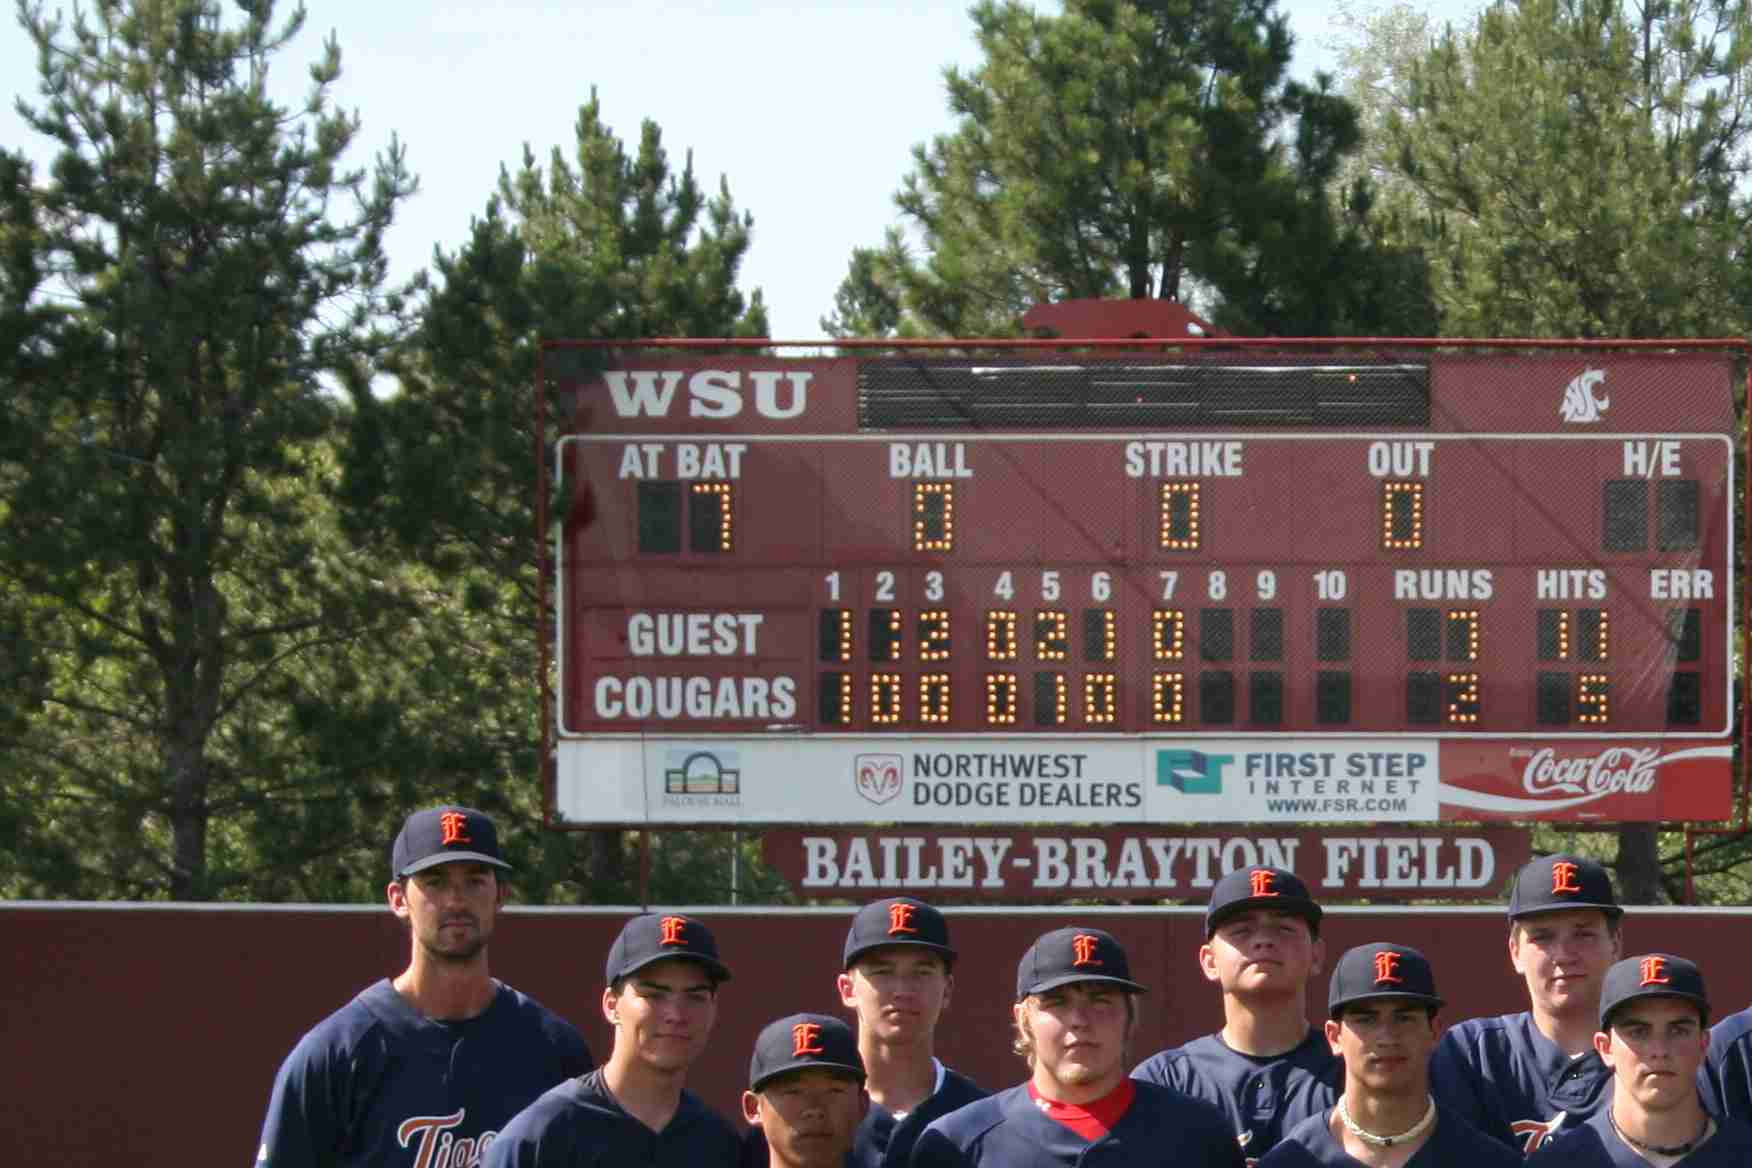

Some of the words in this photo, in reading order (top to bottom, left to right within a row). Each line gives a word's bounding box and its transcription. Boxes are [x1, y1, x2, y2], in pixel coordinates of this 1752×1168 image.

[605, 369, 814, 420] WSU
[618, 442, 665, 479] AT
[676, 442, 748, 479] BAT
[888, 440, 974, 479] BALL
[1124, 439, 1243, 479] STRIKE
[1367, 440, 1435, 478] OUT
[1622, 440, 1682, 479] H/E
[693, 483, 732, 550] 7
[915, 482, 954, 551] 0
[1160, 482, 1201, 550] 0
[1383, 481, 1423, 549] 0
[825, 570, 840, 602] 1
[875, 570, 896, 602] 2
[925, 570, 945, 602] 3
[993, 570, 1015, 602] 4
[1040, 570, 1061, 602] 5
[1091, 570, 1112, 602] 6
[1159, 570, 1179, 601] 7
[1207, 570, 1227, 602] 8
[1256, 569, 1277, 601] 9
[1313, 569, 1347, 601] 10
[1394, 568, 1493, 601] RUNS
[1536, 568, 1607, 601] HITS
[1650, 568, 1714, 600] ERR
[628, 613, 764, 656] GUEST
[920, 610, 949, 660] 2
[986, 610, 1017, 660] 0
[1037, 610, 1066, 660] 2
[1153, 610, 1184, 659] 0
[1449, 610, 1478, 660] 7
[594, 675, 797, 720] COUGARS
[871, 673, 901, 723] 0
[920, 673, 950, 723] 0
[986, 673, 1018, 724] 0
[1085, 673, 1115, 723] 0
[1152, 672, 1183, 722] 0
[1579, 673, 1608, 723] 5
[913, 753, 1087, 779] NORTHWEST
[1245, 753, 1335, 778] FIRST
[1345, 752, 1426, 777] STEP
[1523, 747, 1659, 794] Coca-Cola
[913, 782, 1010, 807] DODGE
[1019, 782, 1142, 808] DEALERS
[1249, 779, 1419, 795] INTERNET
[1266, 798, 1407, 813] WWW.FSR.COM
[802, 837, 1299, 888] BAILEY-BRAYTON
[1322, 837, 1495, 888] FIELD
